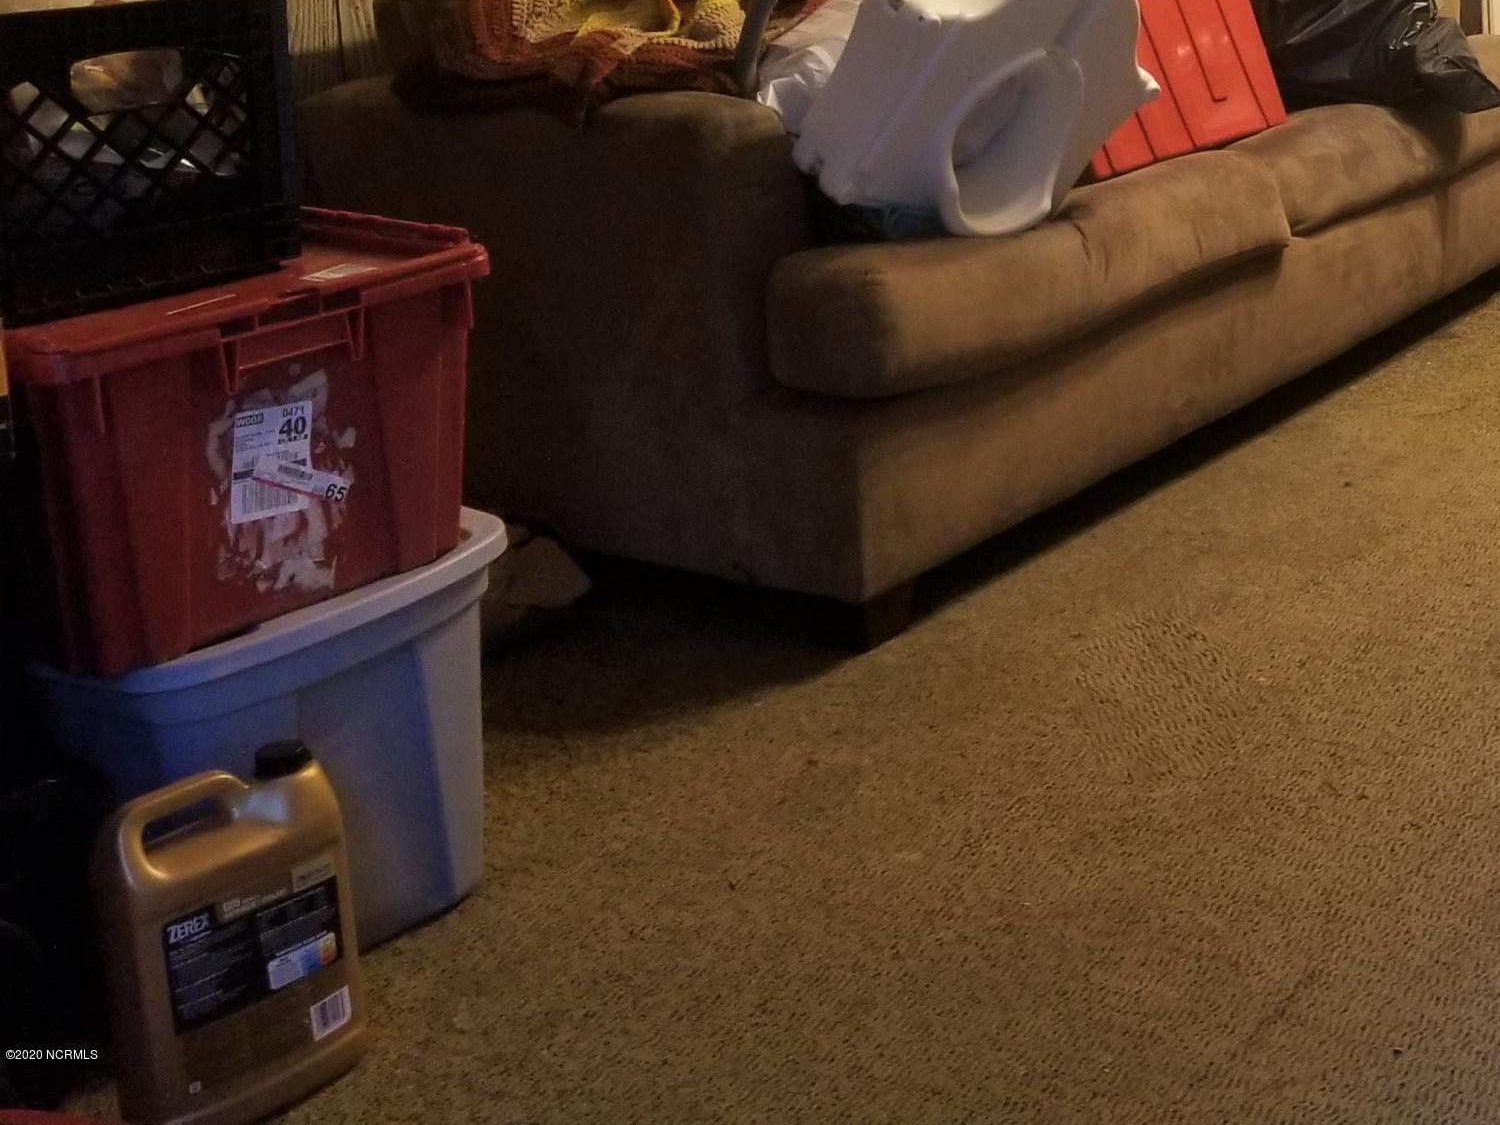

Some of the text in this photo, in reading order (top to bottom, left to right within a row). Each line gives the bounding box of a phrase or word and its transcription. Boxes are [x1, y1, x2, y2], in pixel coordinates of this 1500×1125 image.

[279, 416, 307, 437] 40
[326, 484, 347, 502] 65
[167, 913, 208, 944] ZEREX
